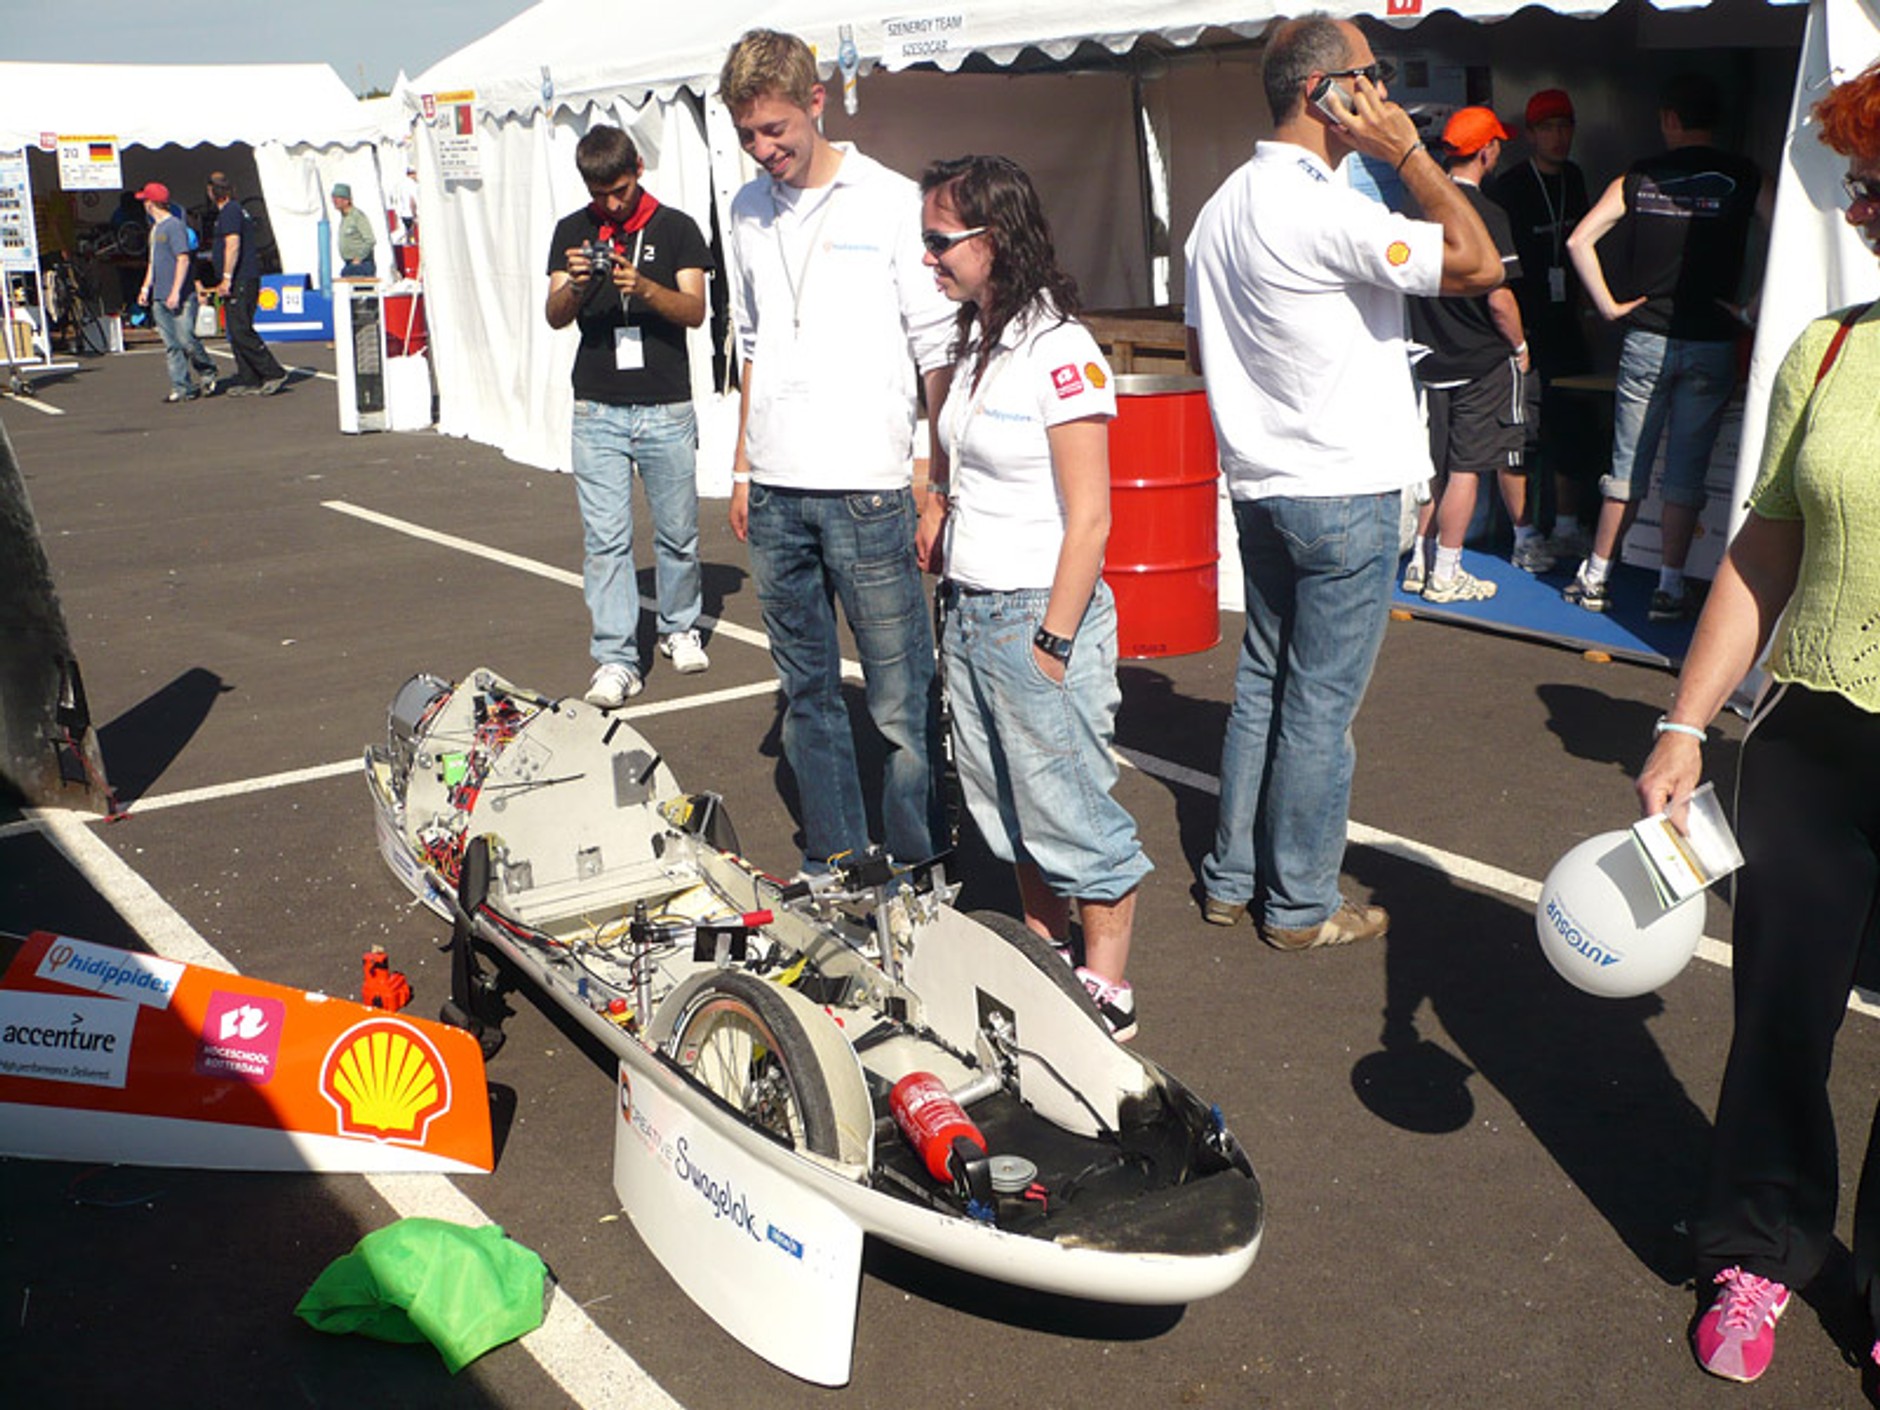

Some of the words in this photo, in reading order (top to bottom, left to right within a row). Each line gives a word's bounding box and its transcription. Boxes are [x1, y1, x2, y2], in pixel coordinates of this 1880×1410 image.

[934, 15, 963, 31] TEAM
[1547, 899, 1620, 966] AUTOSUR
[3, 1024, 117, 1053] accenture
[204, 1045, 269, 1065] HOGESCHOOL
[205, 1058, 265, 1076] ROTTERDAM
[674, 1136, 761, 1242] Swagelok
